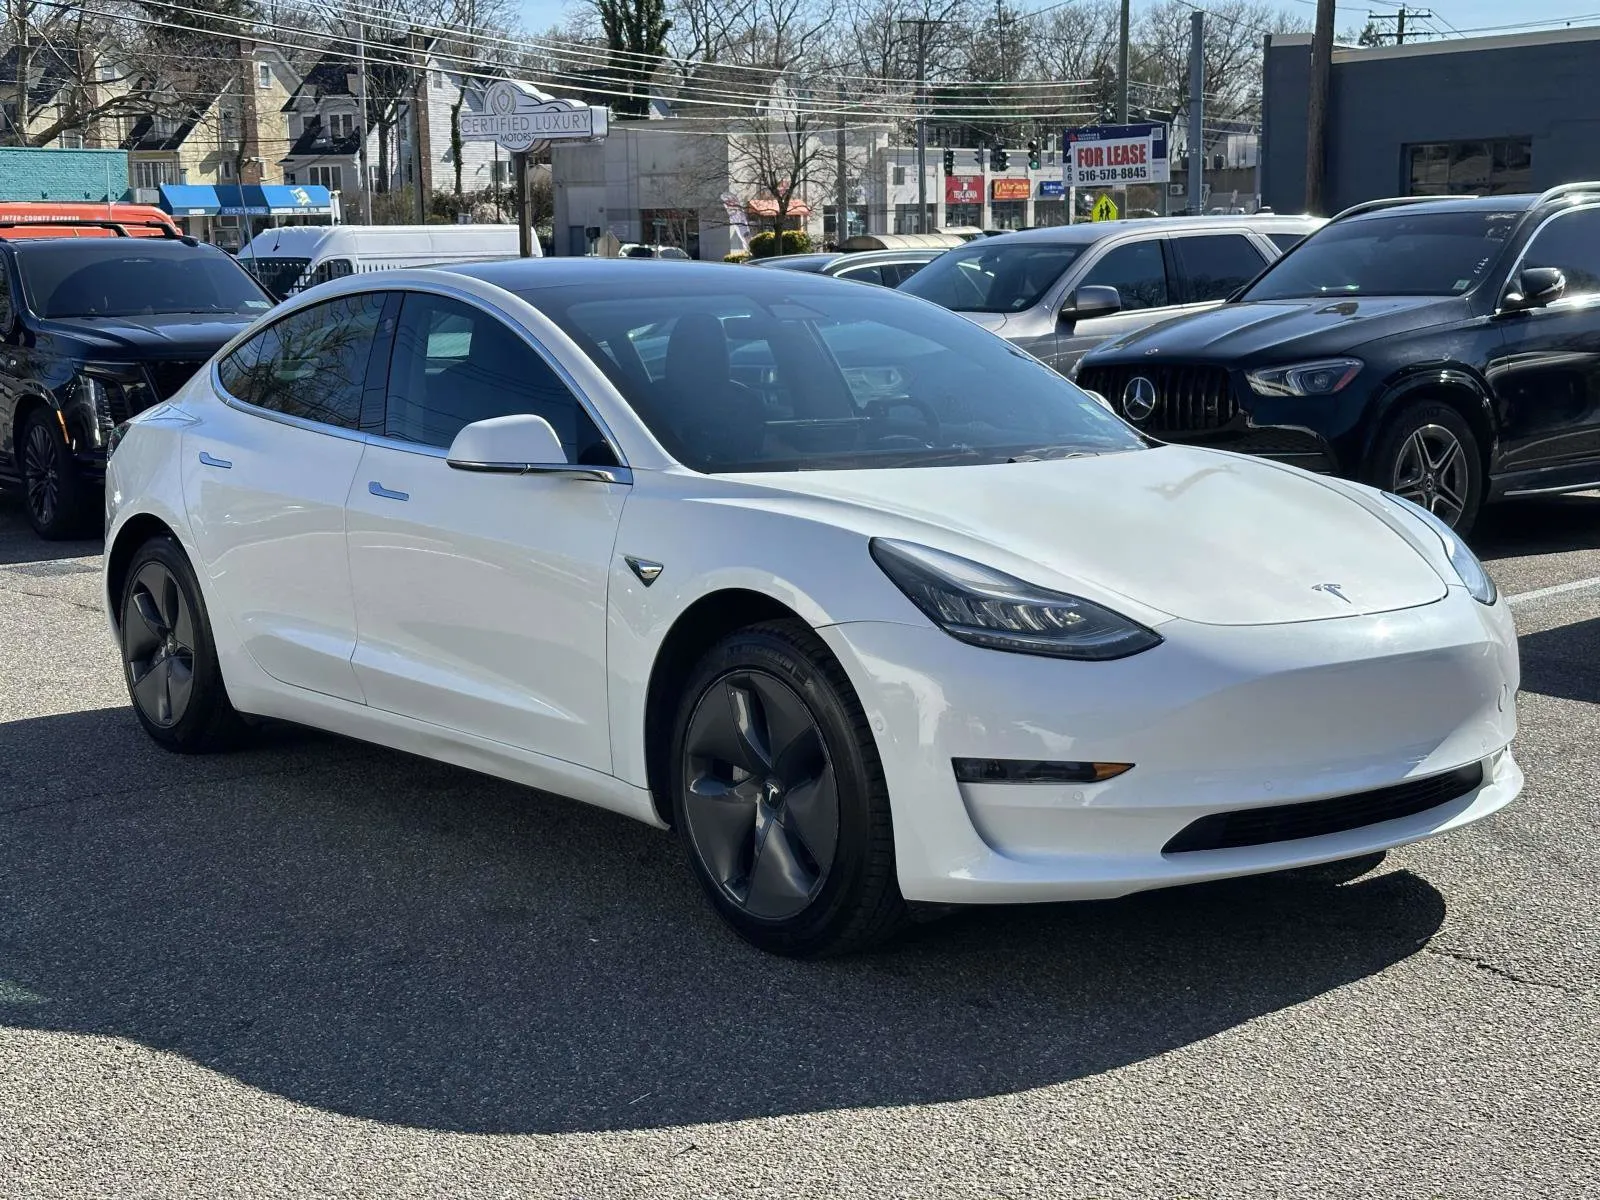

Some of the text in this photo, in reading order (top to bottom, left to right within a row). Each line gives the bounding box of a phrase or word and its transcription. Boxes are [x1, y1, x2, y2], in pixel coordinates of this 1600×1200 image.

[461, 113, 589, 133] CERTIFIED LUXURY
[500, 132, 532, 143] MOTORS
[1077, 143, 1147, 168] FOR LEASE
[1078, 166, 1147, 182] 516-578-8845
